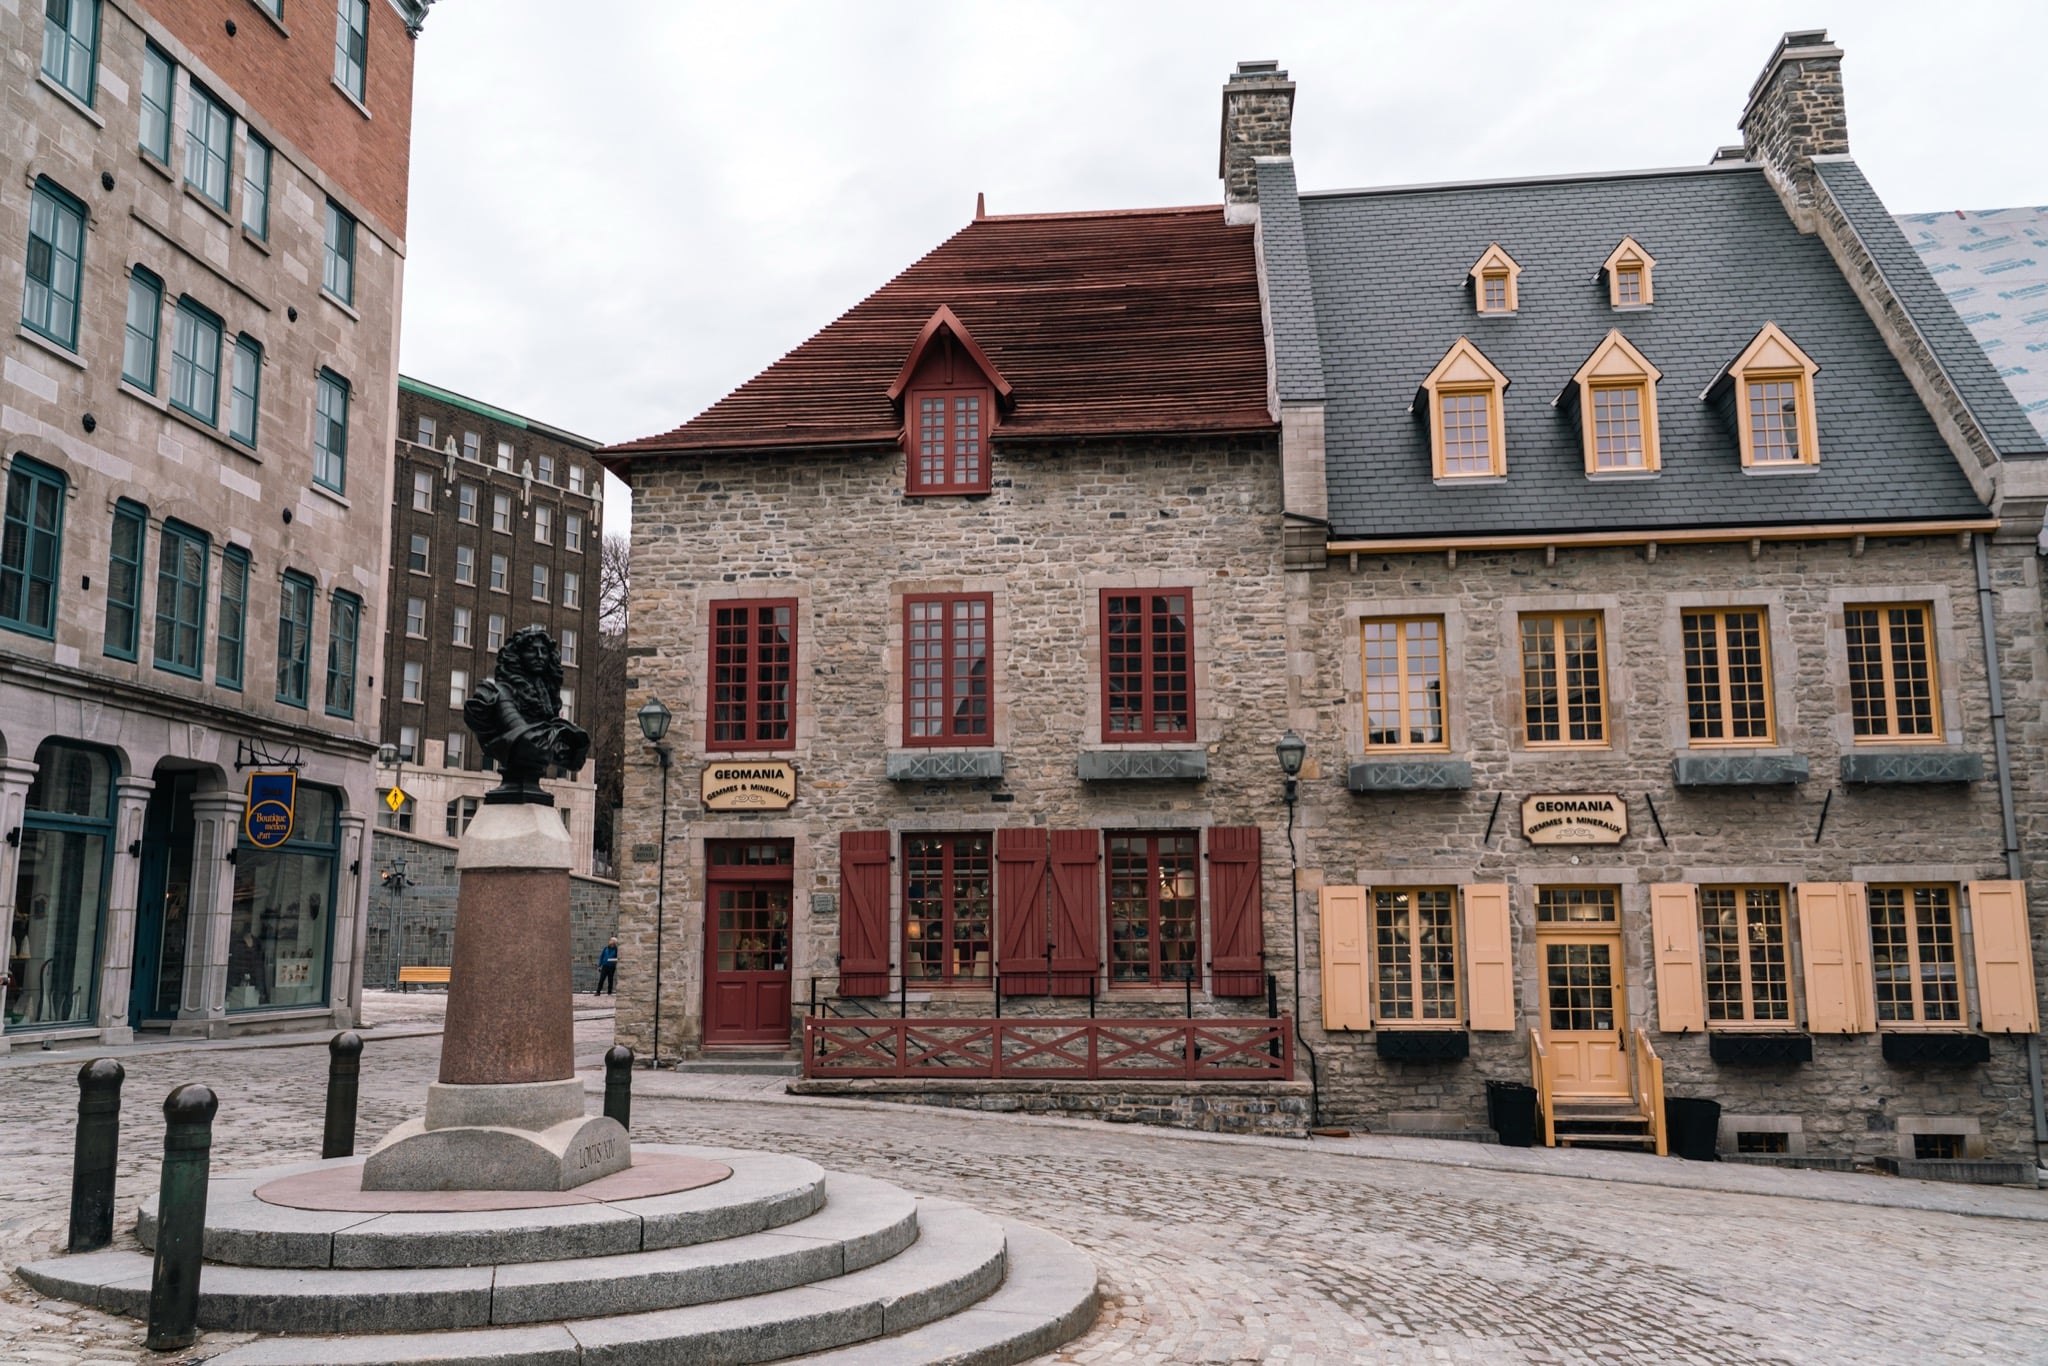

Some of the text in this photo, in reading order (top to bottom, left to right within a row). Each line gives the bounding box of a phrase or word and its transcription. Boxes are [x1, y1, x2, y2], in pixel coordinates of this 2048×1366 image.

[714, 769, 784, 780] GEOMANIA
[706, 783, 791, 801] GEMMES & MINERAUX
[1535, 800, 1614, 812] GEOMANIA
[256, 812, 287, 825] Boutique
[1528, 816, 1622, 835] GEMMES & MINERAUX
